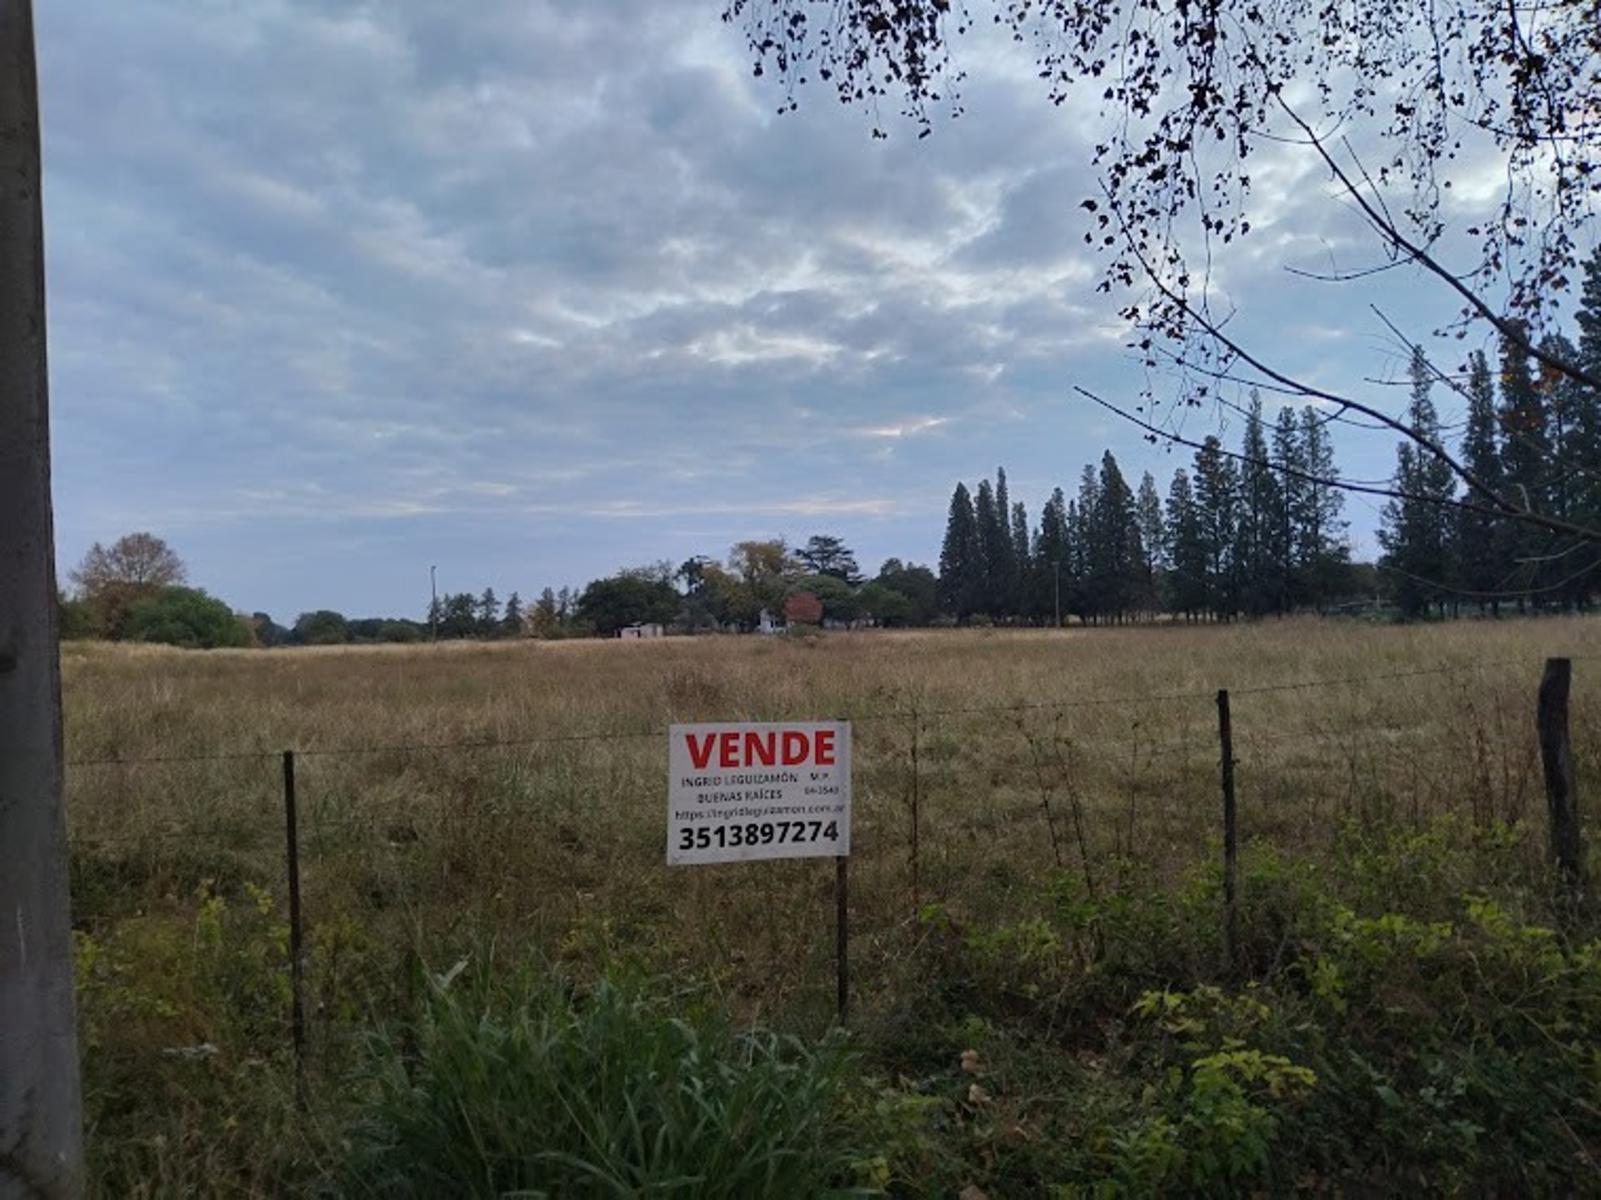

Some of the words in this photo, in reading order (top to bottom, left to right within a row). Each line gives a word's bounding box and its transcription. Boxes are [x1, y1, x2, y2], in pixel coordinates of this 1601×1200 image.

[685, 730, 835, 769] VENDE
[681, 776, 722, 788] INGRID
[697, 791, 742, 804] BUENAS
[745, 788, 783, 801] RAÍCES
[679, 820, 839, 850] 3513897274
